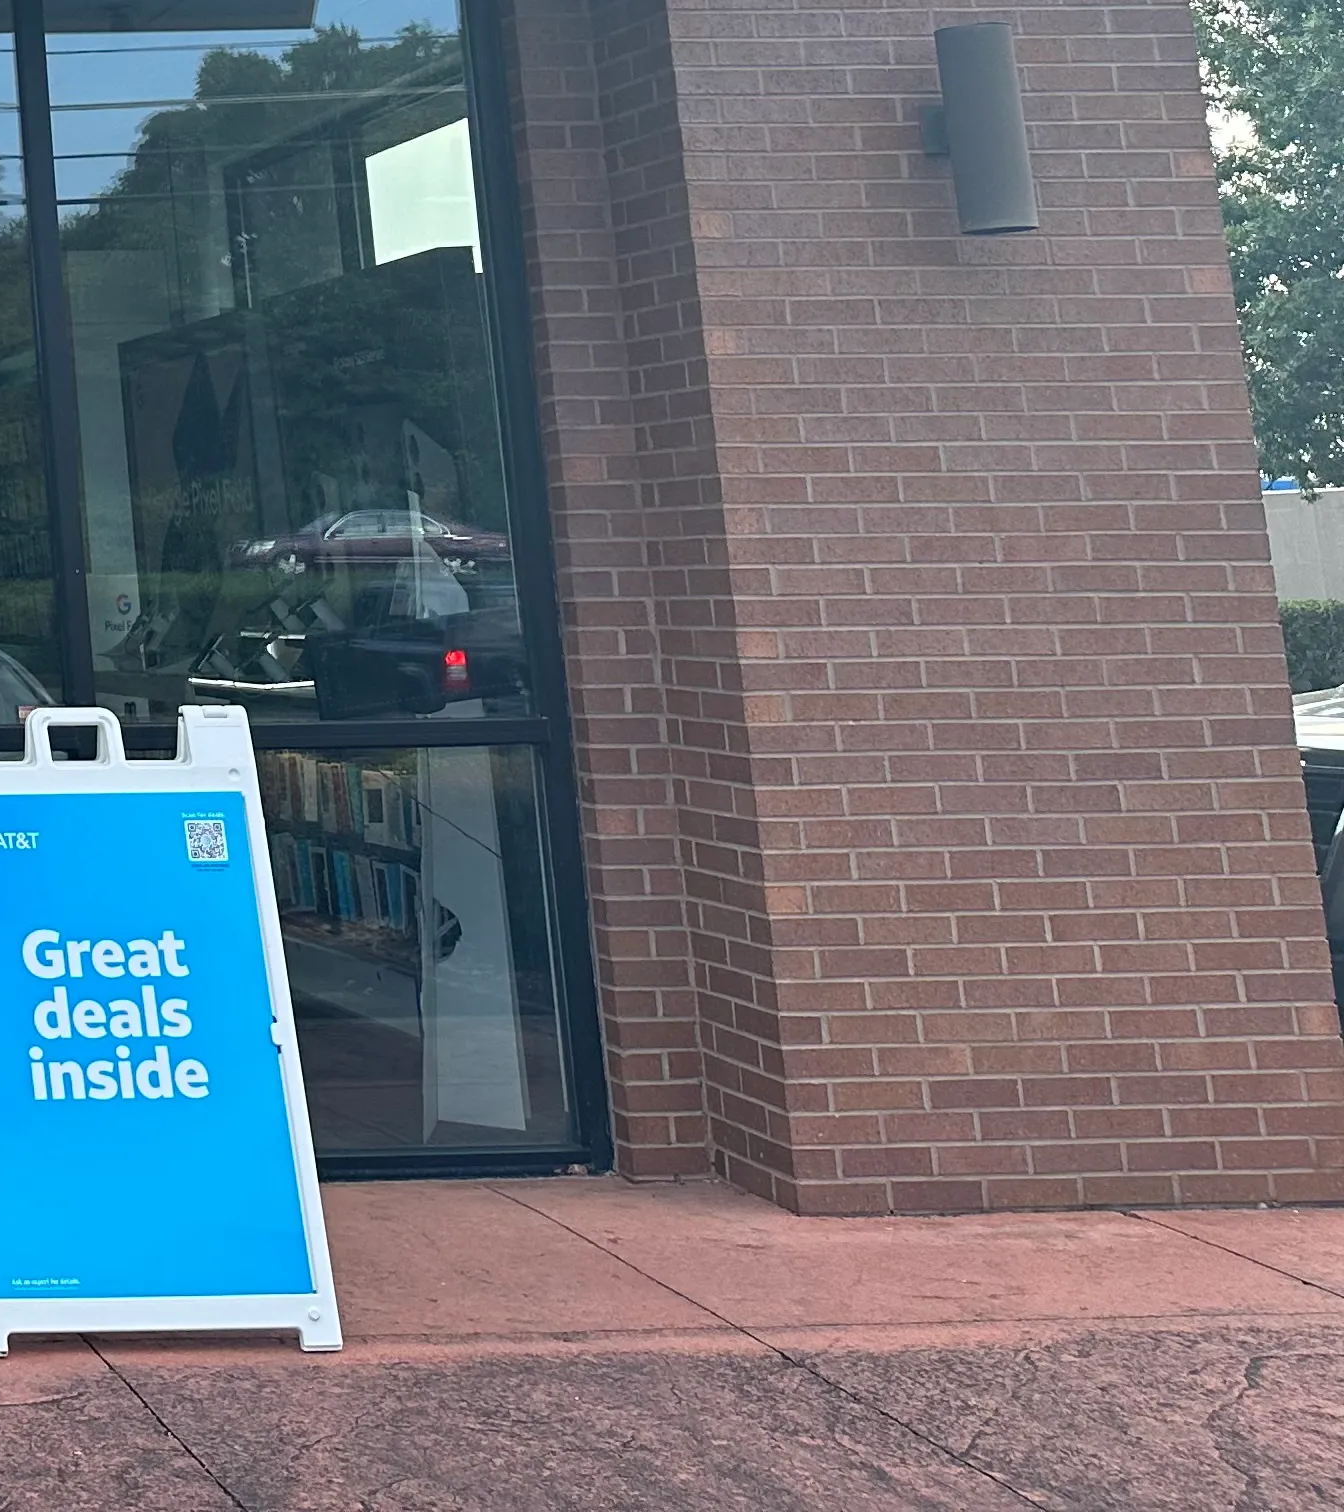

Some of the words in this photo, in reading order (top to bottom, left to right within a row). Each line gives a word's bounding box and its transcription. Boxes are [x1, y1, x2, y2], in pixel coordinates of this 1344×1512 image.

[22, 928, 189, 979] Great
[34, 985, 192, 1040] deals
[29, 1045, 209, 1101] inside
